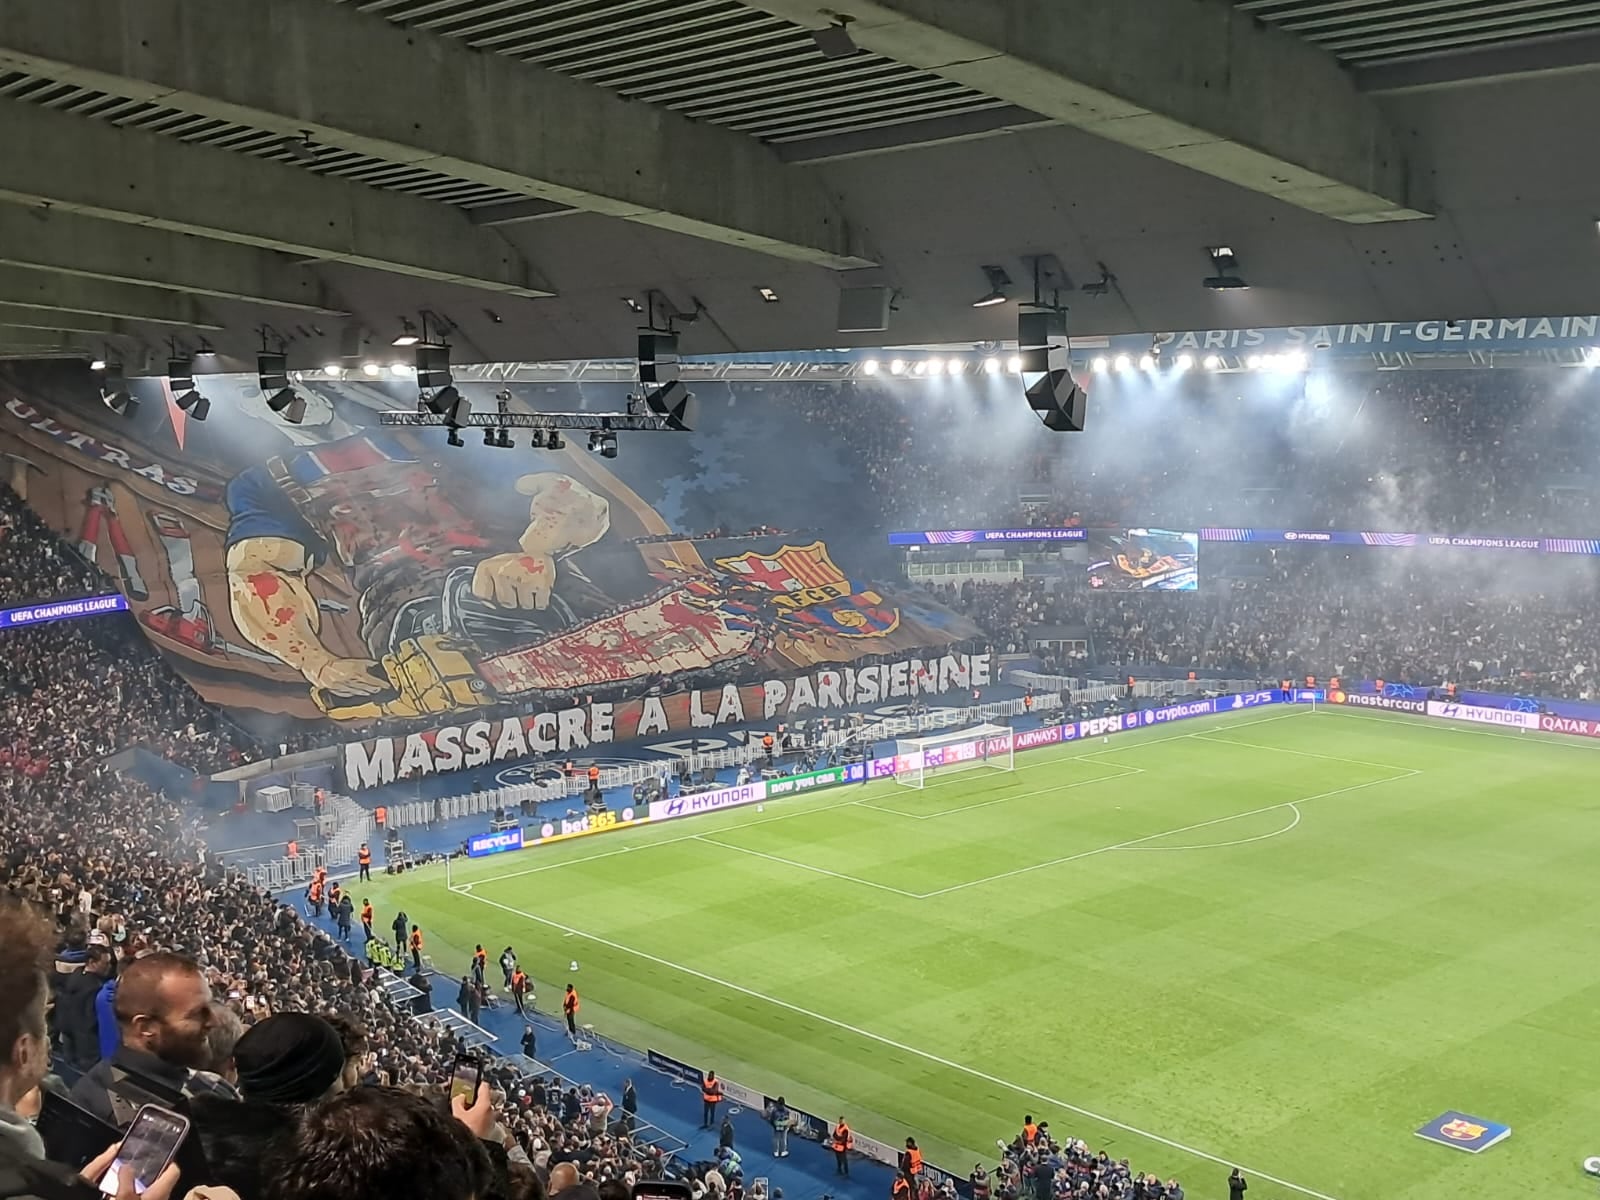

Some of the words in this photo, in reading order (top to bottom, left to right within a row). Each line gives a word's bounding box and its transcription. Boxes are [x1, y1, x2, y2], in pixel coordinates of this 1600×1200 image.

[5, 398, 198, 495] ULTRAS
[985, 531, 1004, 540] UEFA
[1006, 531, 1051, 539] CHAMPIONS
[1053, 530, 1083, 538] LEAGUE
[1429, 536, 1450, 545] UEFA
[1452, 537, 1503, 548] CHAMPIONS
[1505, 540, 1539, 549] LEAGUE
[790, 586, 842, 605] FCB
[10, 611, 33, 622] UEFA
[34, 602, 83, 619] CHAMPIONS
[84, 598, 117, 612] LEAGUE
[1245, 691, 1272, 705] PS5
[1348, 692, 1425, 712] mastercard
[345, 702, 614, 791] MASSACRE
[689, 683, 746, 729] LA
[763, 653, 991, 721] PARISIENNE
[1156, 701, 1210, 722] crypto.com
[1466, 709, 1527, 725] HYUNDAI
[1080, 714, 1122, 737] PEPSI
[1542, 717, 1588, 734] QATAR
[1016, 727, 1058, 747] AIRWAYS
[873, 755, 910, 776] FedEx
[924, 745, 958, 767] FedEx
[771, 781, 793, 794] now
[795, 776, 815, 792] you
[816, 773, 836, 784] can
[692, 788, 754, 811] HYUNDAI
[561, 811, 617, 834] bet365
[472, 832, 520, 851] RECYCLE
